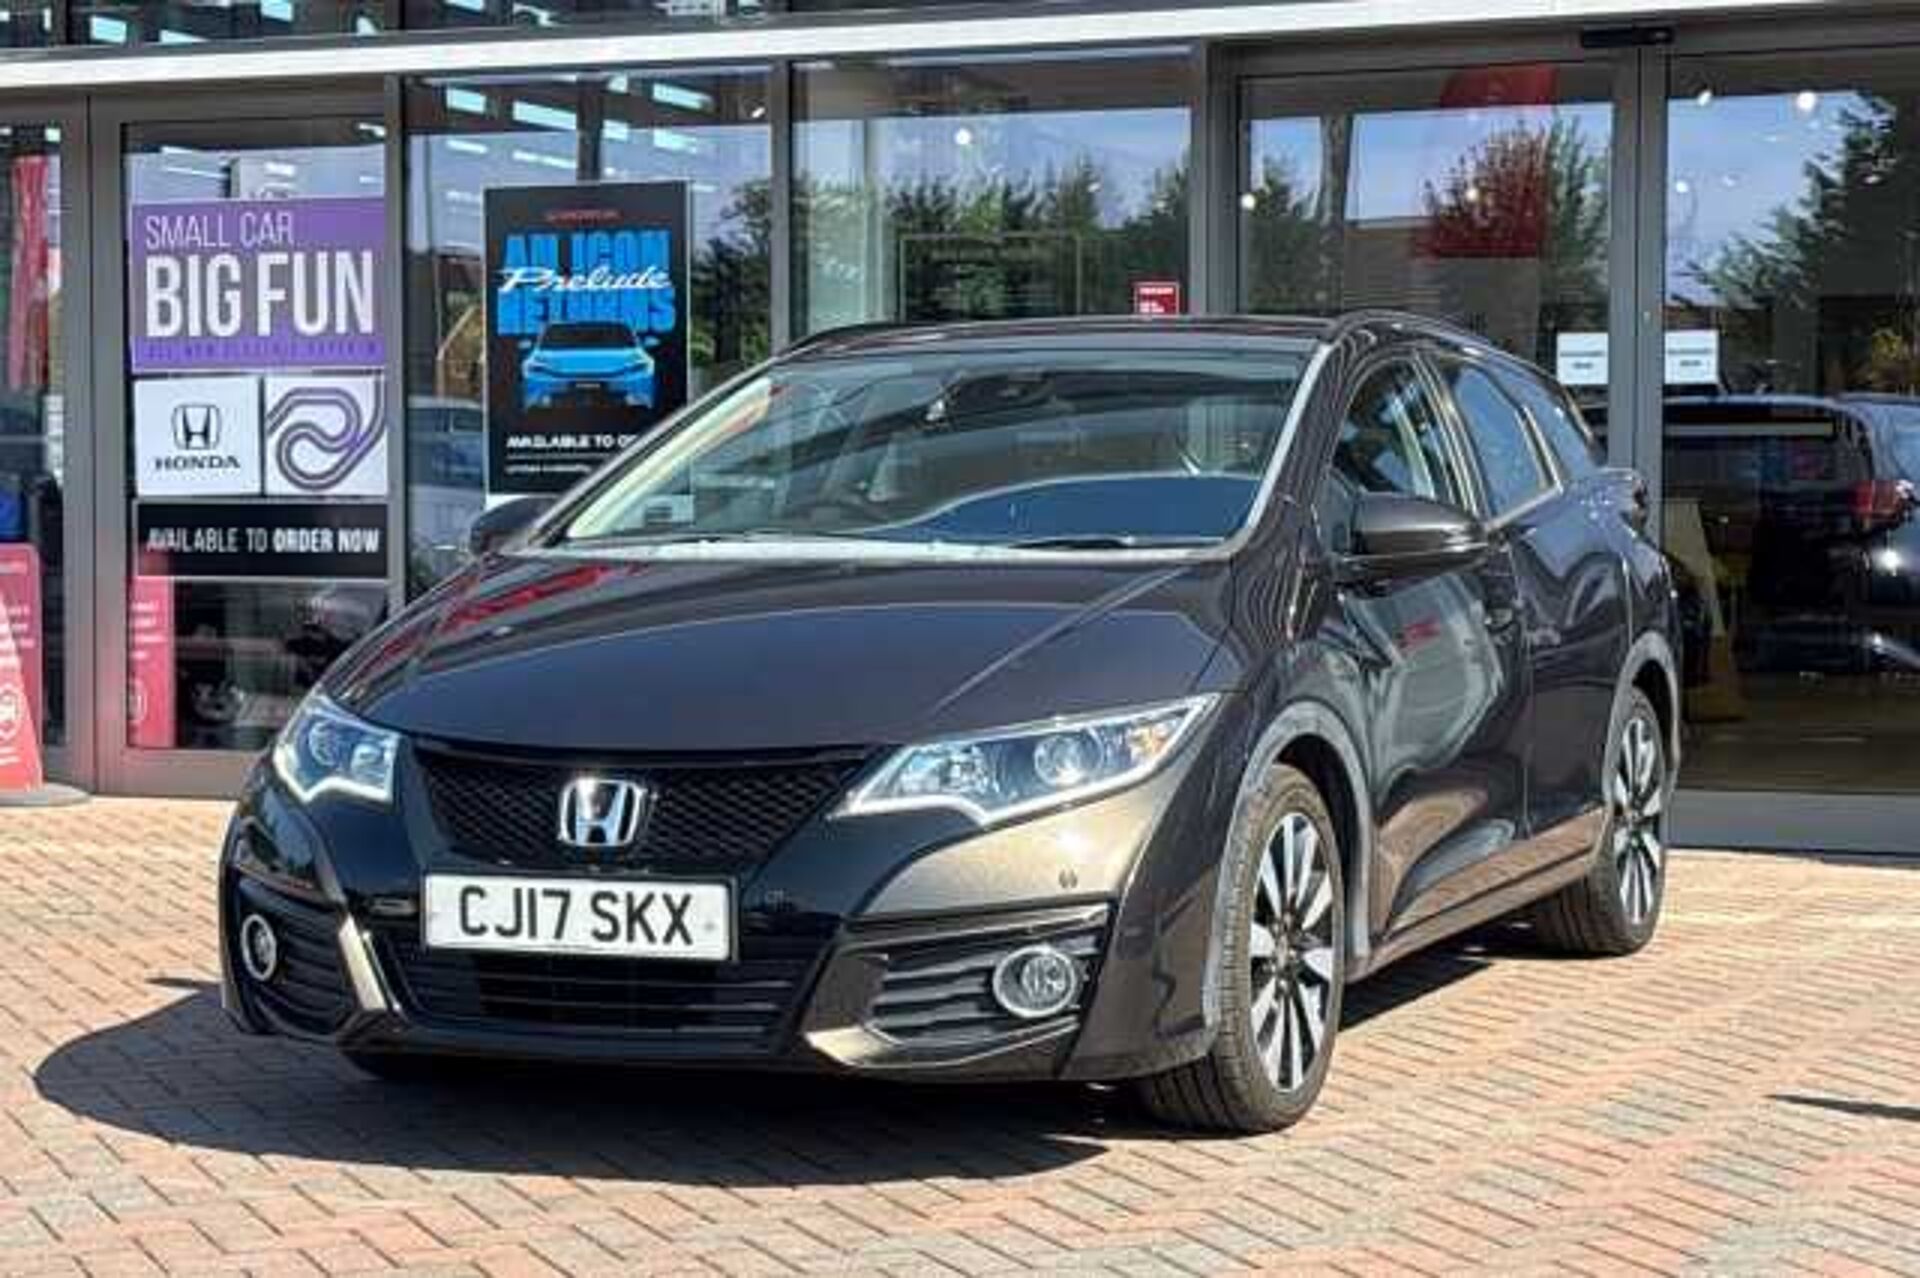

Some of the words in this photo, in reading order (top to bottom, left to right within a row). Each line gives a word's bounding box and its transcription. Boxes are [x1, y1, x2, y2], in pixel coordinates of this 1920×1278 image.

[145, 213, 229, 249] SMALL
[240, 211, 294, 246] CAR
[145, 252, 241, 338] BIG
[258, 250, 373, 336] FUN
[496, 264, 673, 294] Prelude
[506, 435, 590, 448] AVAILABLE
[594, 435, 614, 448] TO
[154, 455, 241, 472] HONDA
[146, 528, 237, 553] AVAILABLE
[247, 528, 268, 552] TO
[273, 528, 334, 552] ORDER
[338, 528, 380, 552] NOW
[459, 885, 571, 940] CJ17
[590, 890, 693, 946] SKX
